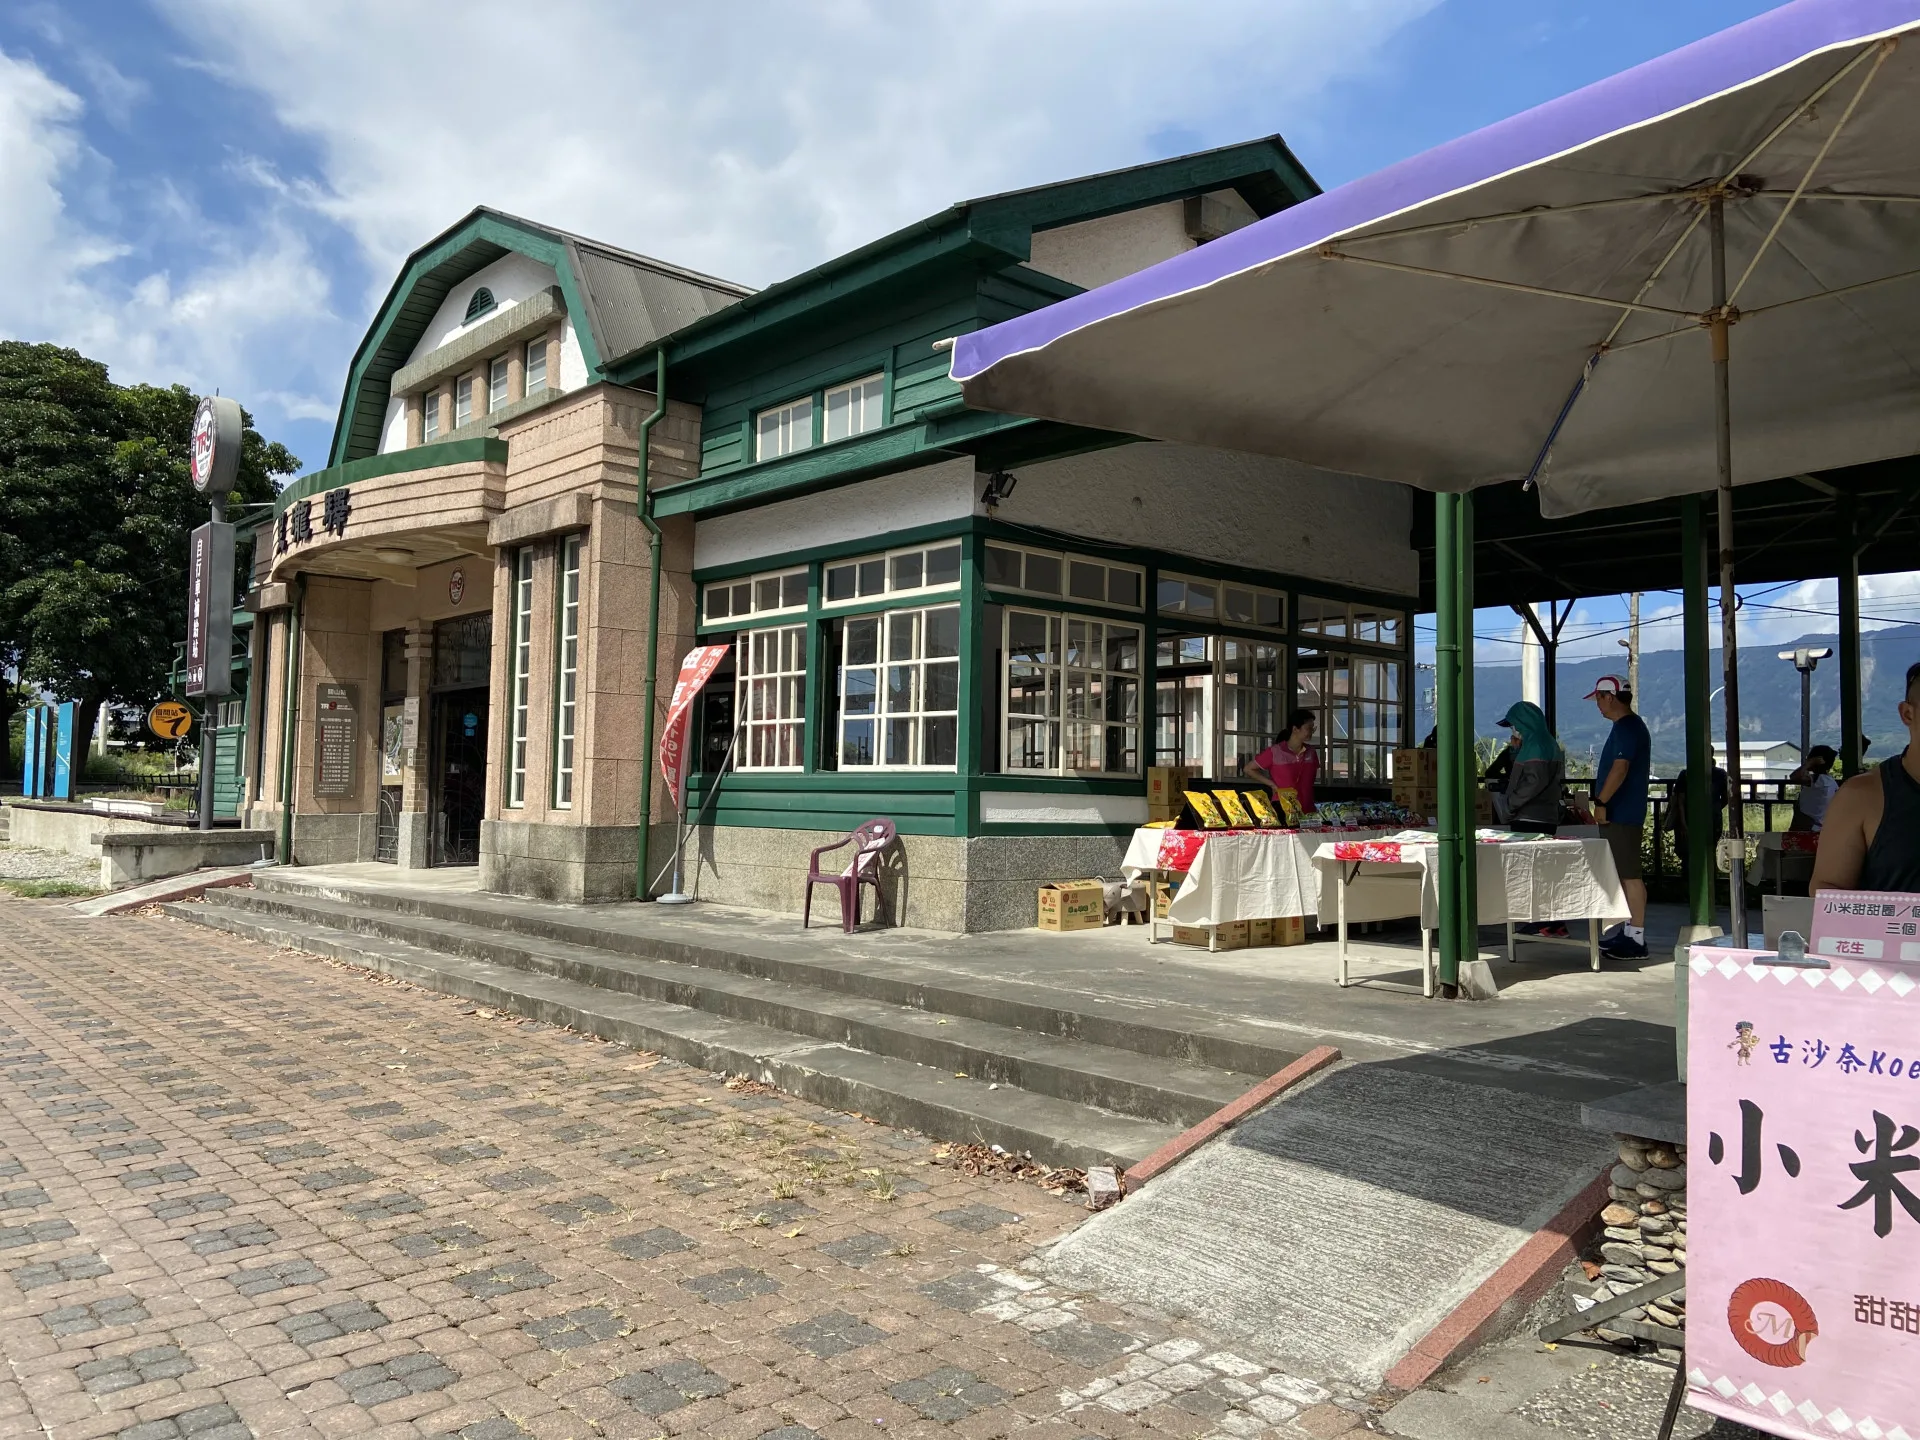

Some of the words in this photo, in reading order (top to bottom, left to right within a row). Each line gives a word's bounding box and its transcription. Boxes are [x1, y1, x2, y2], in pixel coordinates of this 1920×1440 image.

[1835, 940, 1865, 955] 花生
[1709, 1099, 1920, 1238] 小米
[1854, 1294, 1920, 1335] 甜甜
